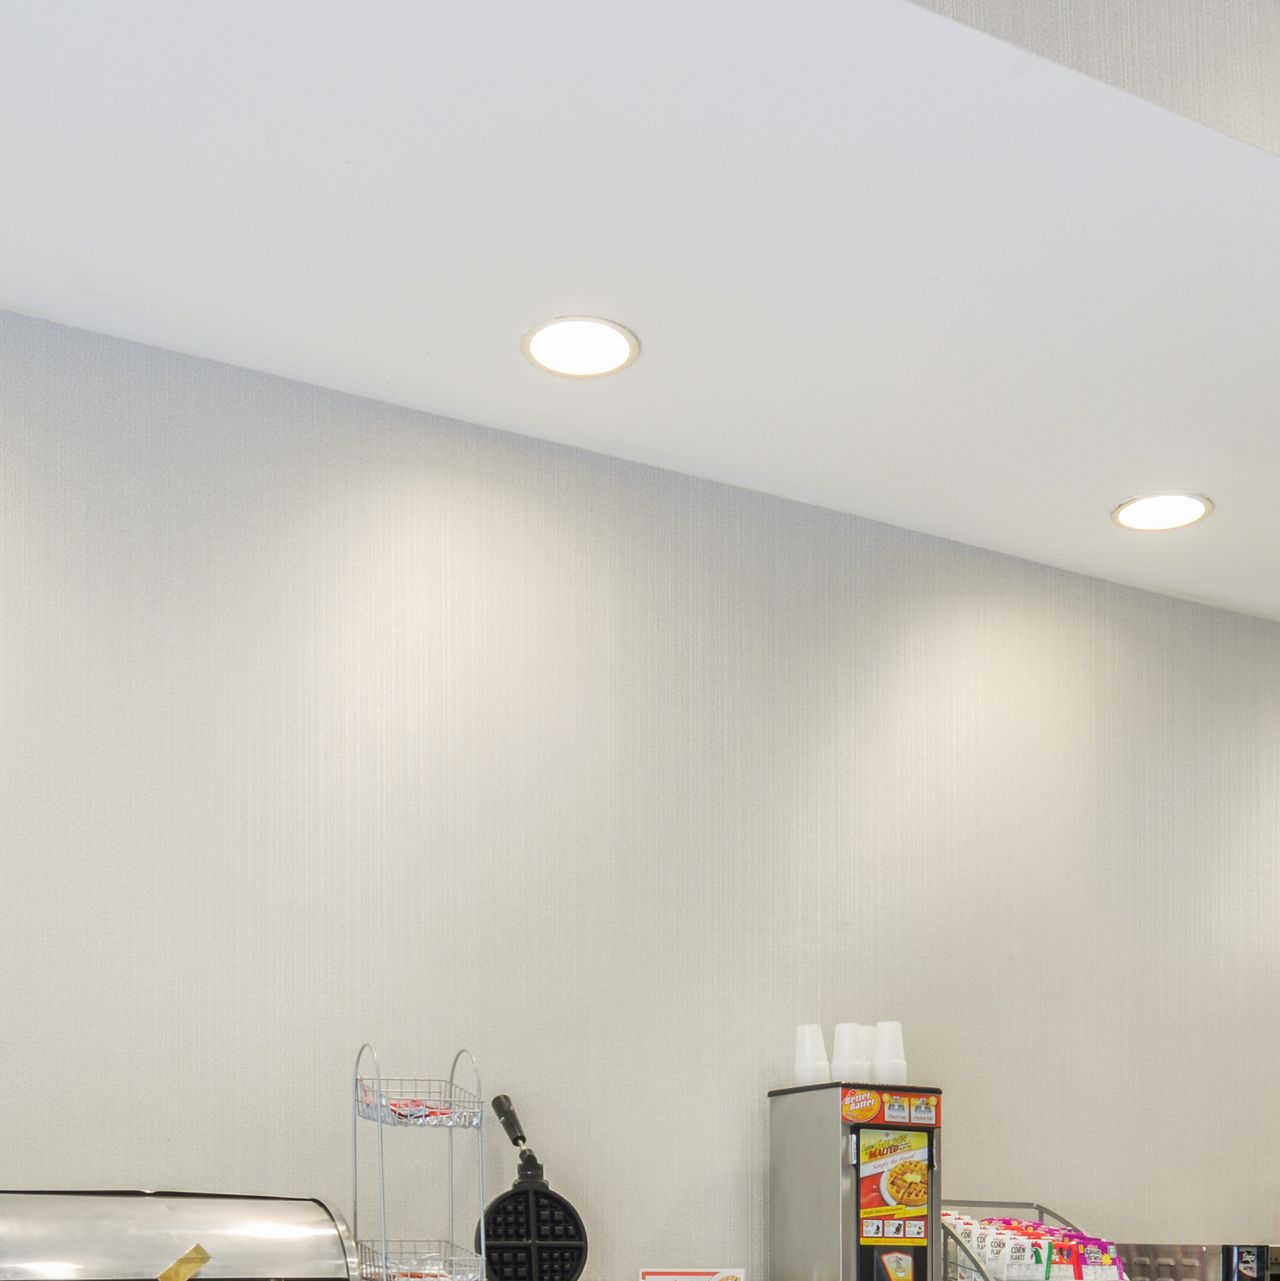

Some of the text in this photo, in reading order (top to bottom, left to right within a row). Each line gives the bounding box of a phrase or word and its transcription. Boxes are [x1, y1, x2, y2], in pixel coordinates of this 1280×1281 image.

[845, 1092, 871, 1105] Better
[849, 1098, 876, 1111] Batter
[868, 1144, 899, 1160] MALTED
[1010, 1246, 1026, 1254] CORN
